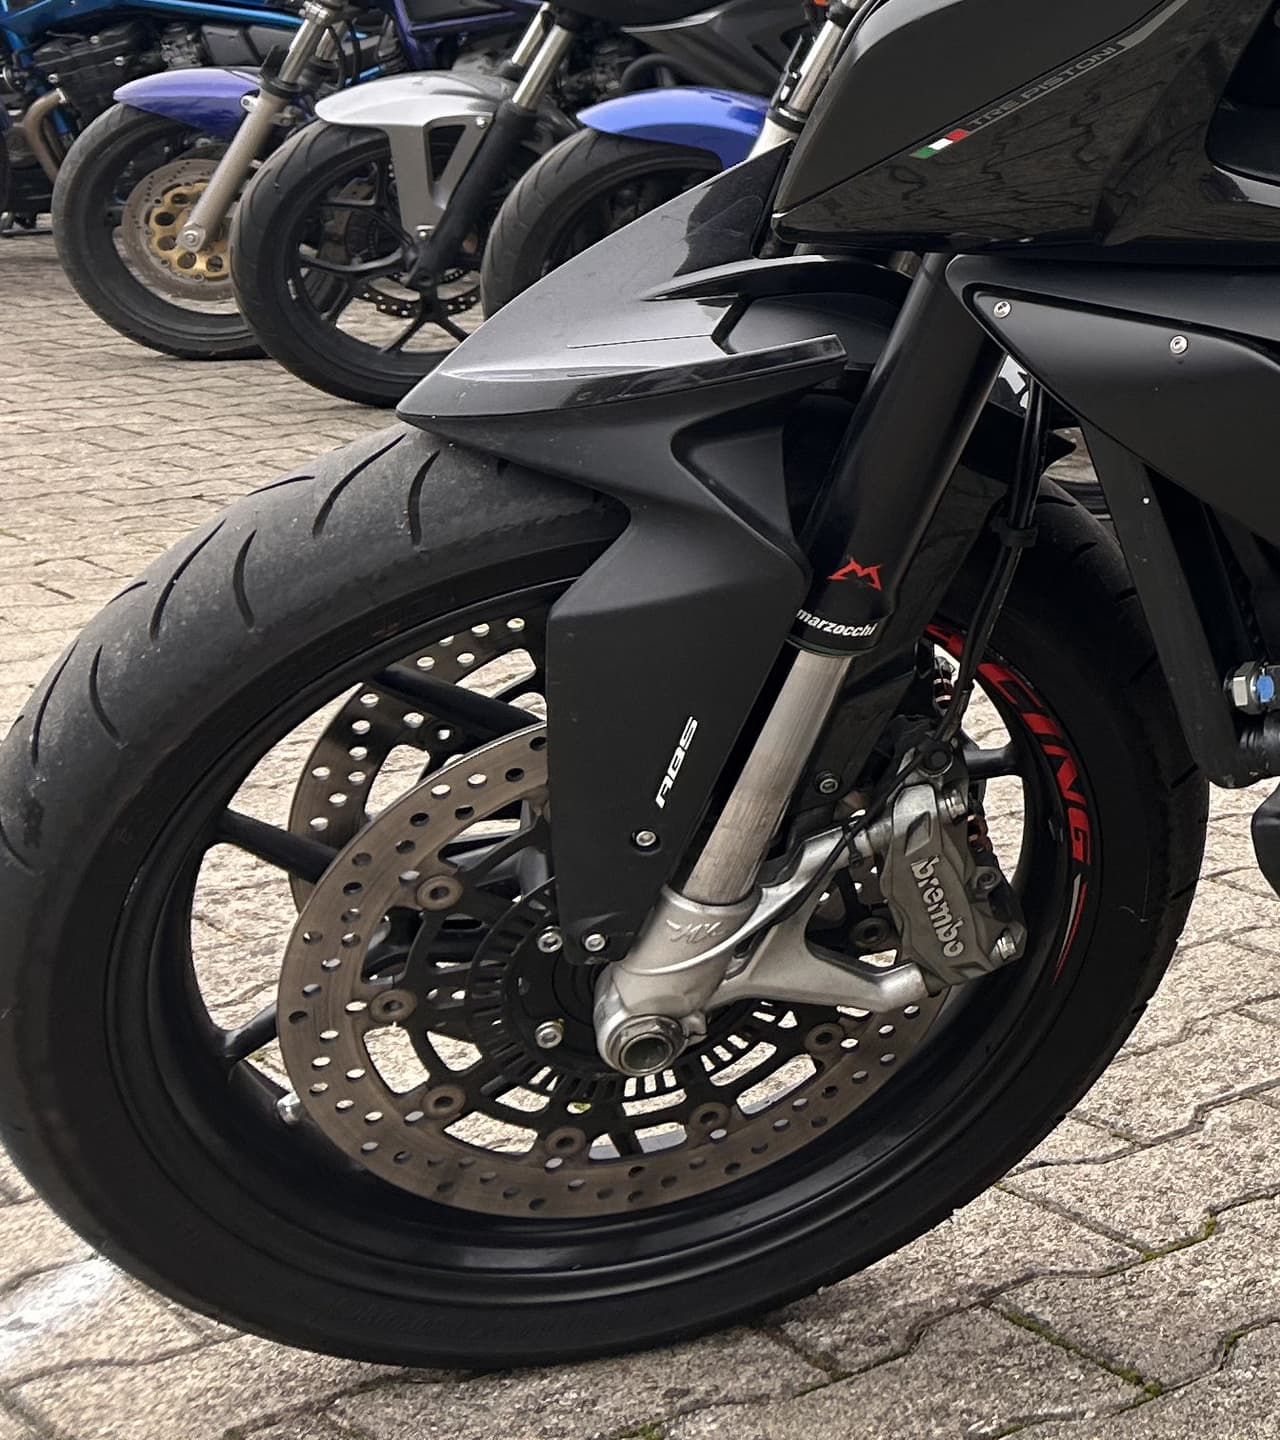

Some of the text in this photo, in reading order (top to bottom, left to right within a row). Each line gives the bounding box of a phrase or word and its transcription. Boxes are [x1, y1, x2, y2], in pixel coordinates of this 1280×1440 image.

[966, 46, 1117, 127] TRE PISTONI
[796, 608, 879, 638] marzocchi
[655, 715, 699, 809] ABS
[910, 855, 966, 959] brembo
